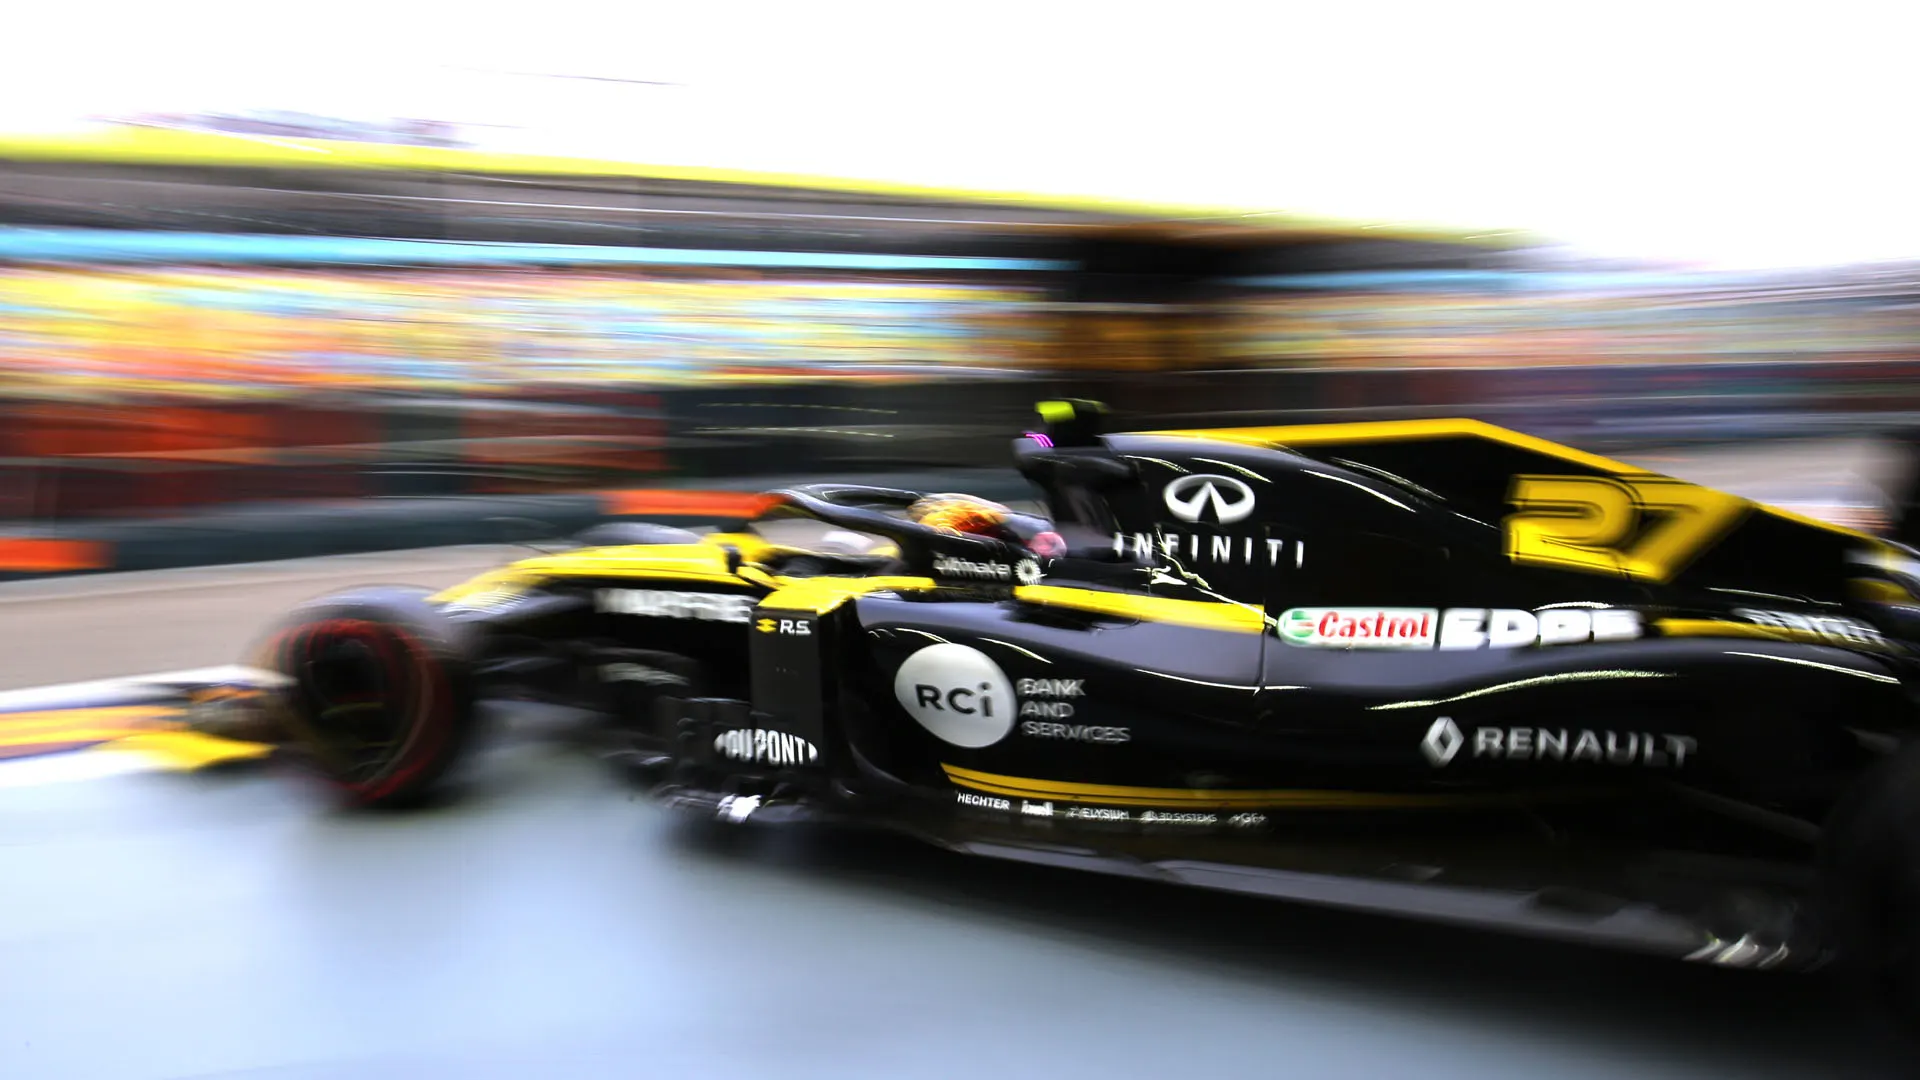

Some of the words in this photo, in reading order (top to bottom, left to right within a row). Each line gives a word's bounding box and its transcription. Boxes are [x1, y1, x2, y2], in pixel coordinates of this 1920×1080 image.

[1502, 473, 1752, 584] 27
[1112, 531, 1305, 569] INFINITI
[1318, 610, 1430, 639] Castrol
[1017, 678, 1086, 698] BANK
[1020, 701, 1074, 718] AND
[1021, 720, 1131, 743] SERVICES
[1473, 726, 1698, 769] RENAULT
[957, 792, 1011, 811] HECHTER
